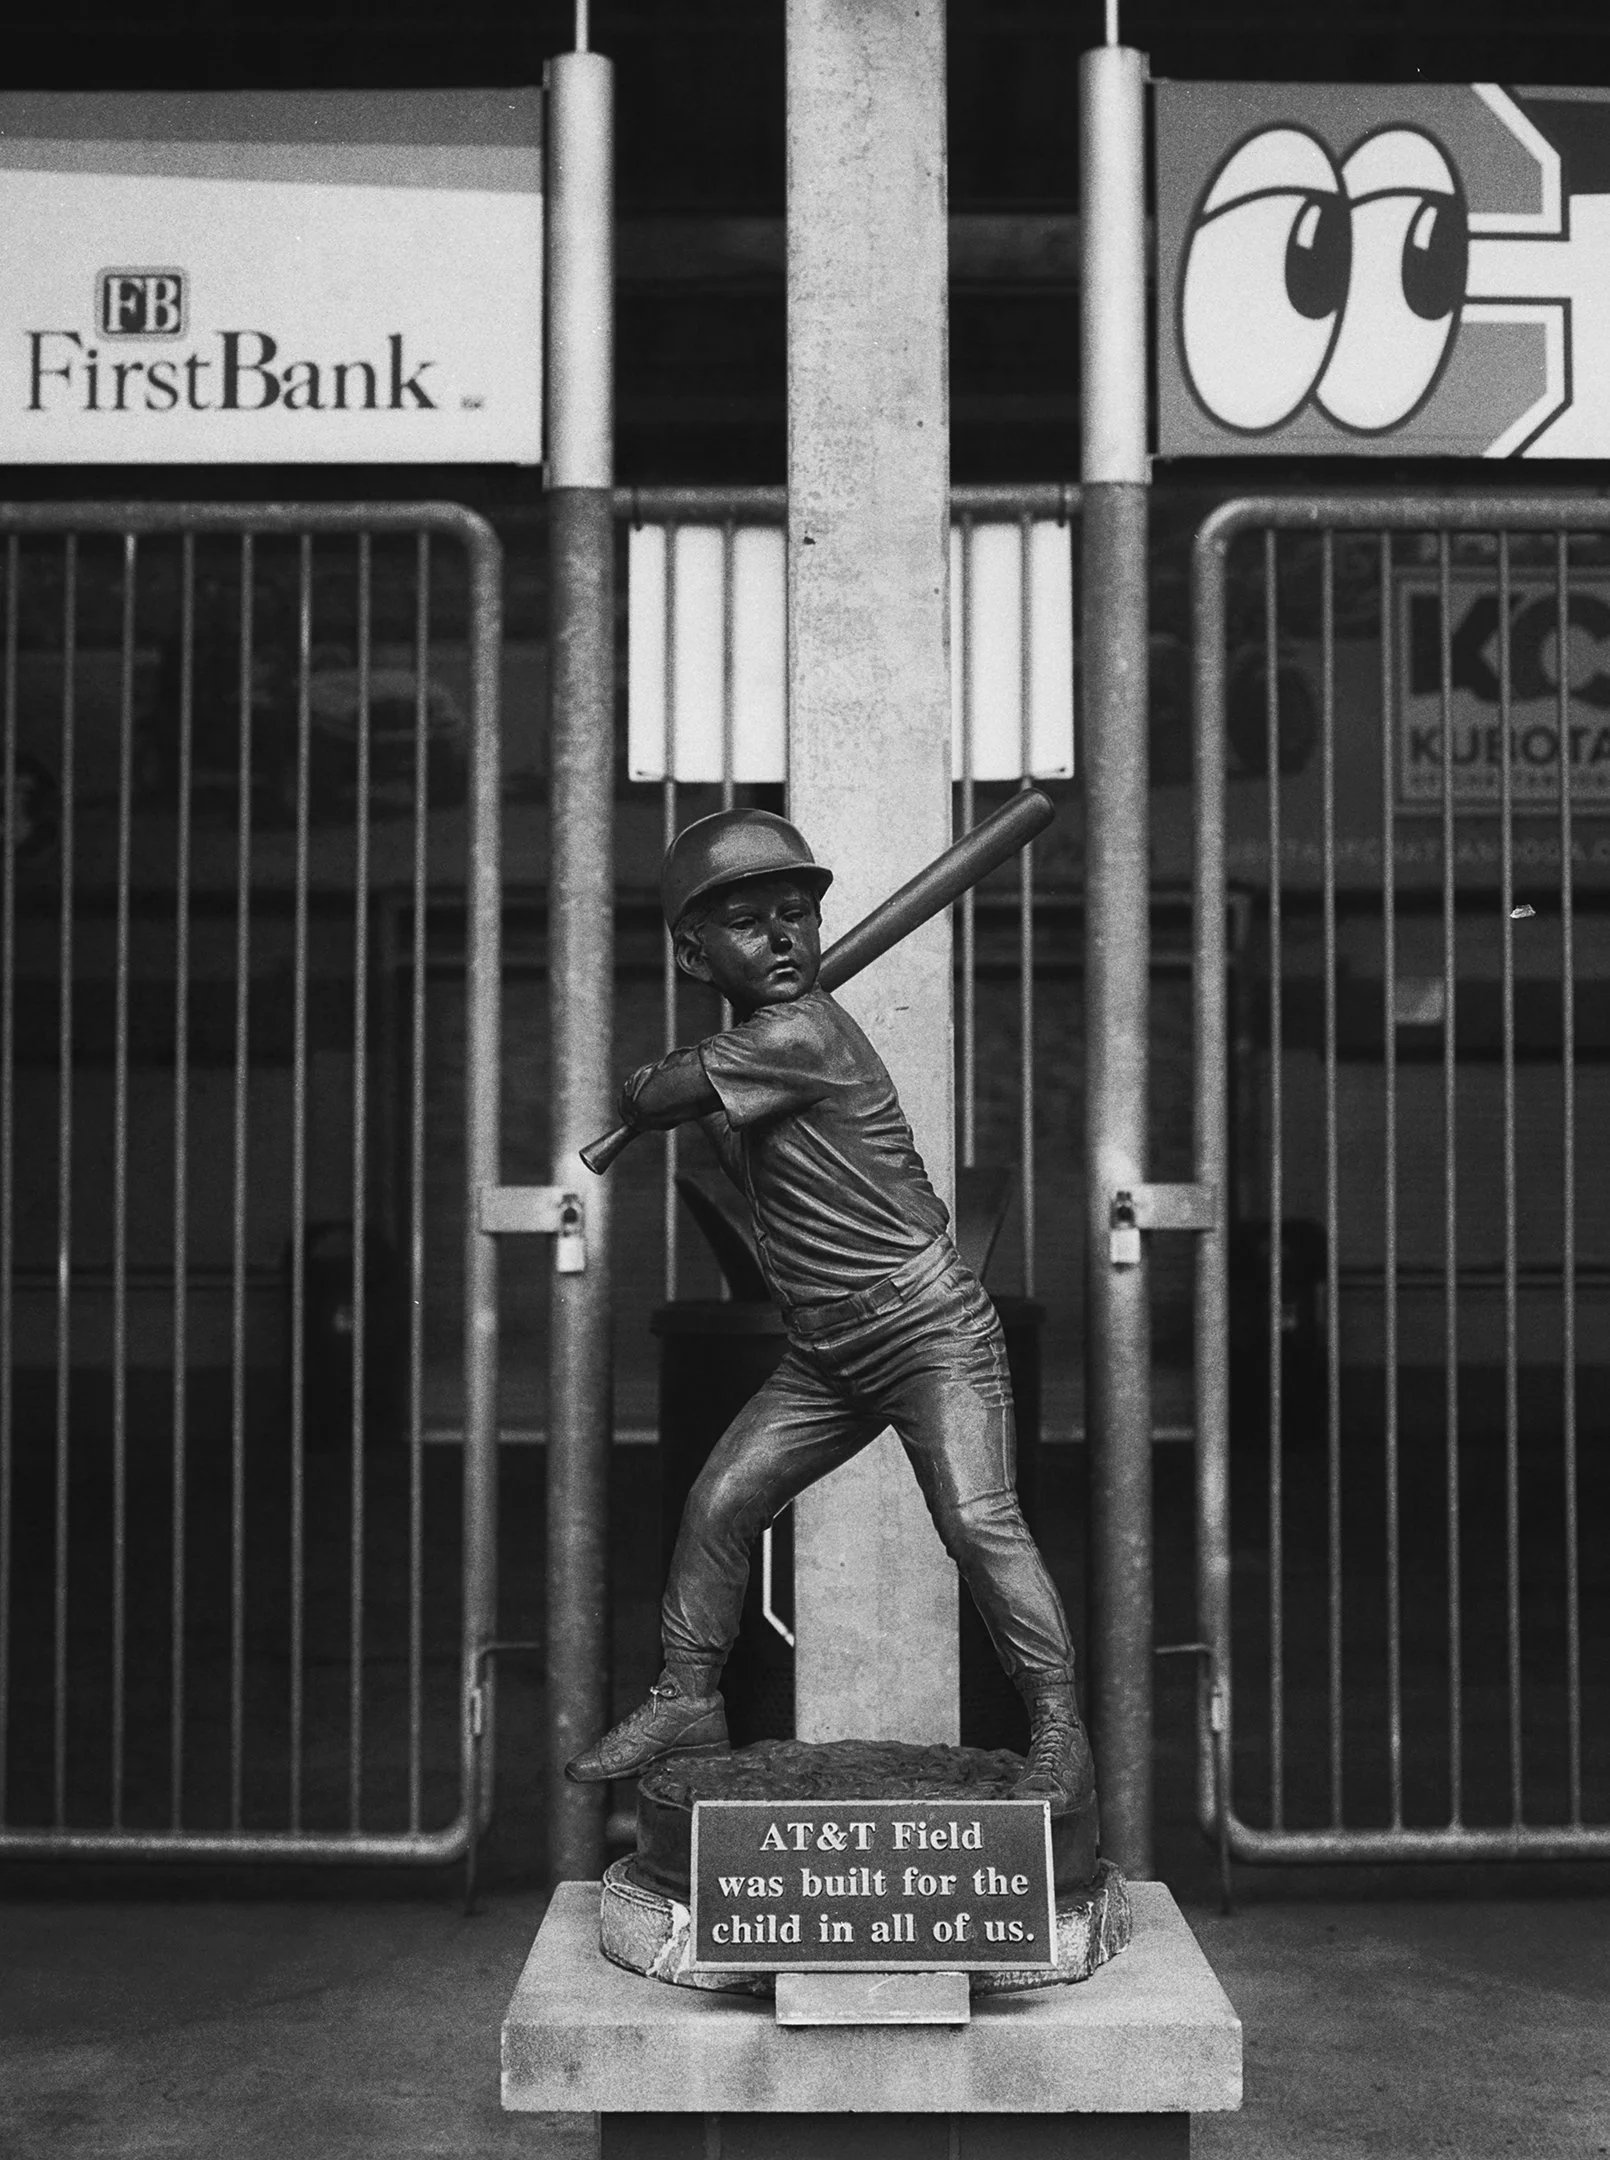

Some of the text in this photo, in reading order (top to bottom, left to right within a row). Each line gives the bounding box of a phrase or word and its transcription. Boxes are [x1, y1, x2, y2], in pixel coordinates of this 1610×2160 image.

[106, 275, 182, 333] FB
[25, 329, 439, 411] FirstBank
[759, 1821, 983, 1851] AT&T Field
[717, 1867, 1029, 1898] was built for the
[711, 1912, 1036, 1944] child in all of us.
